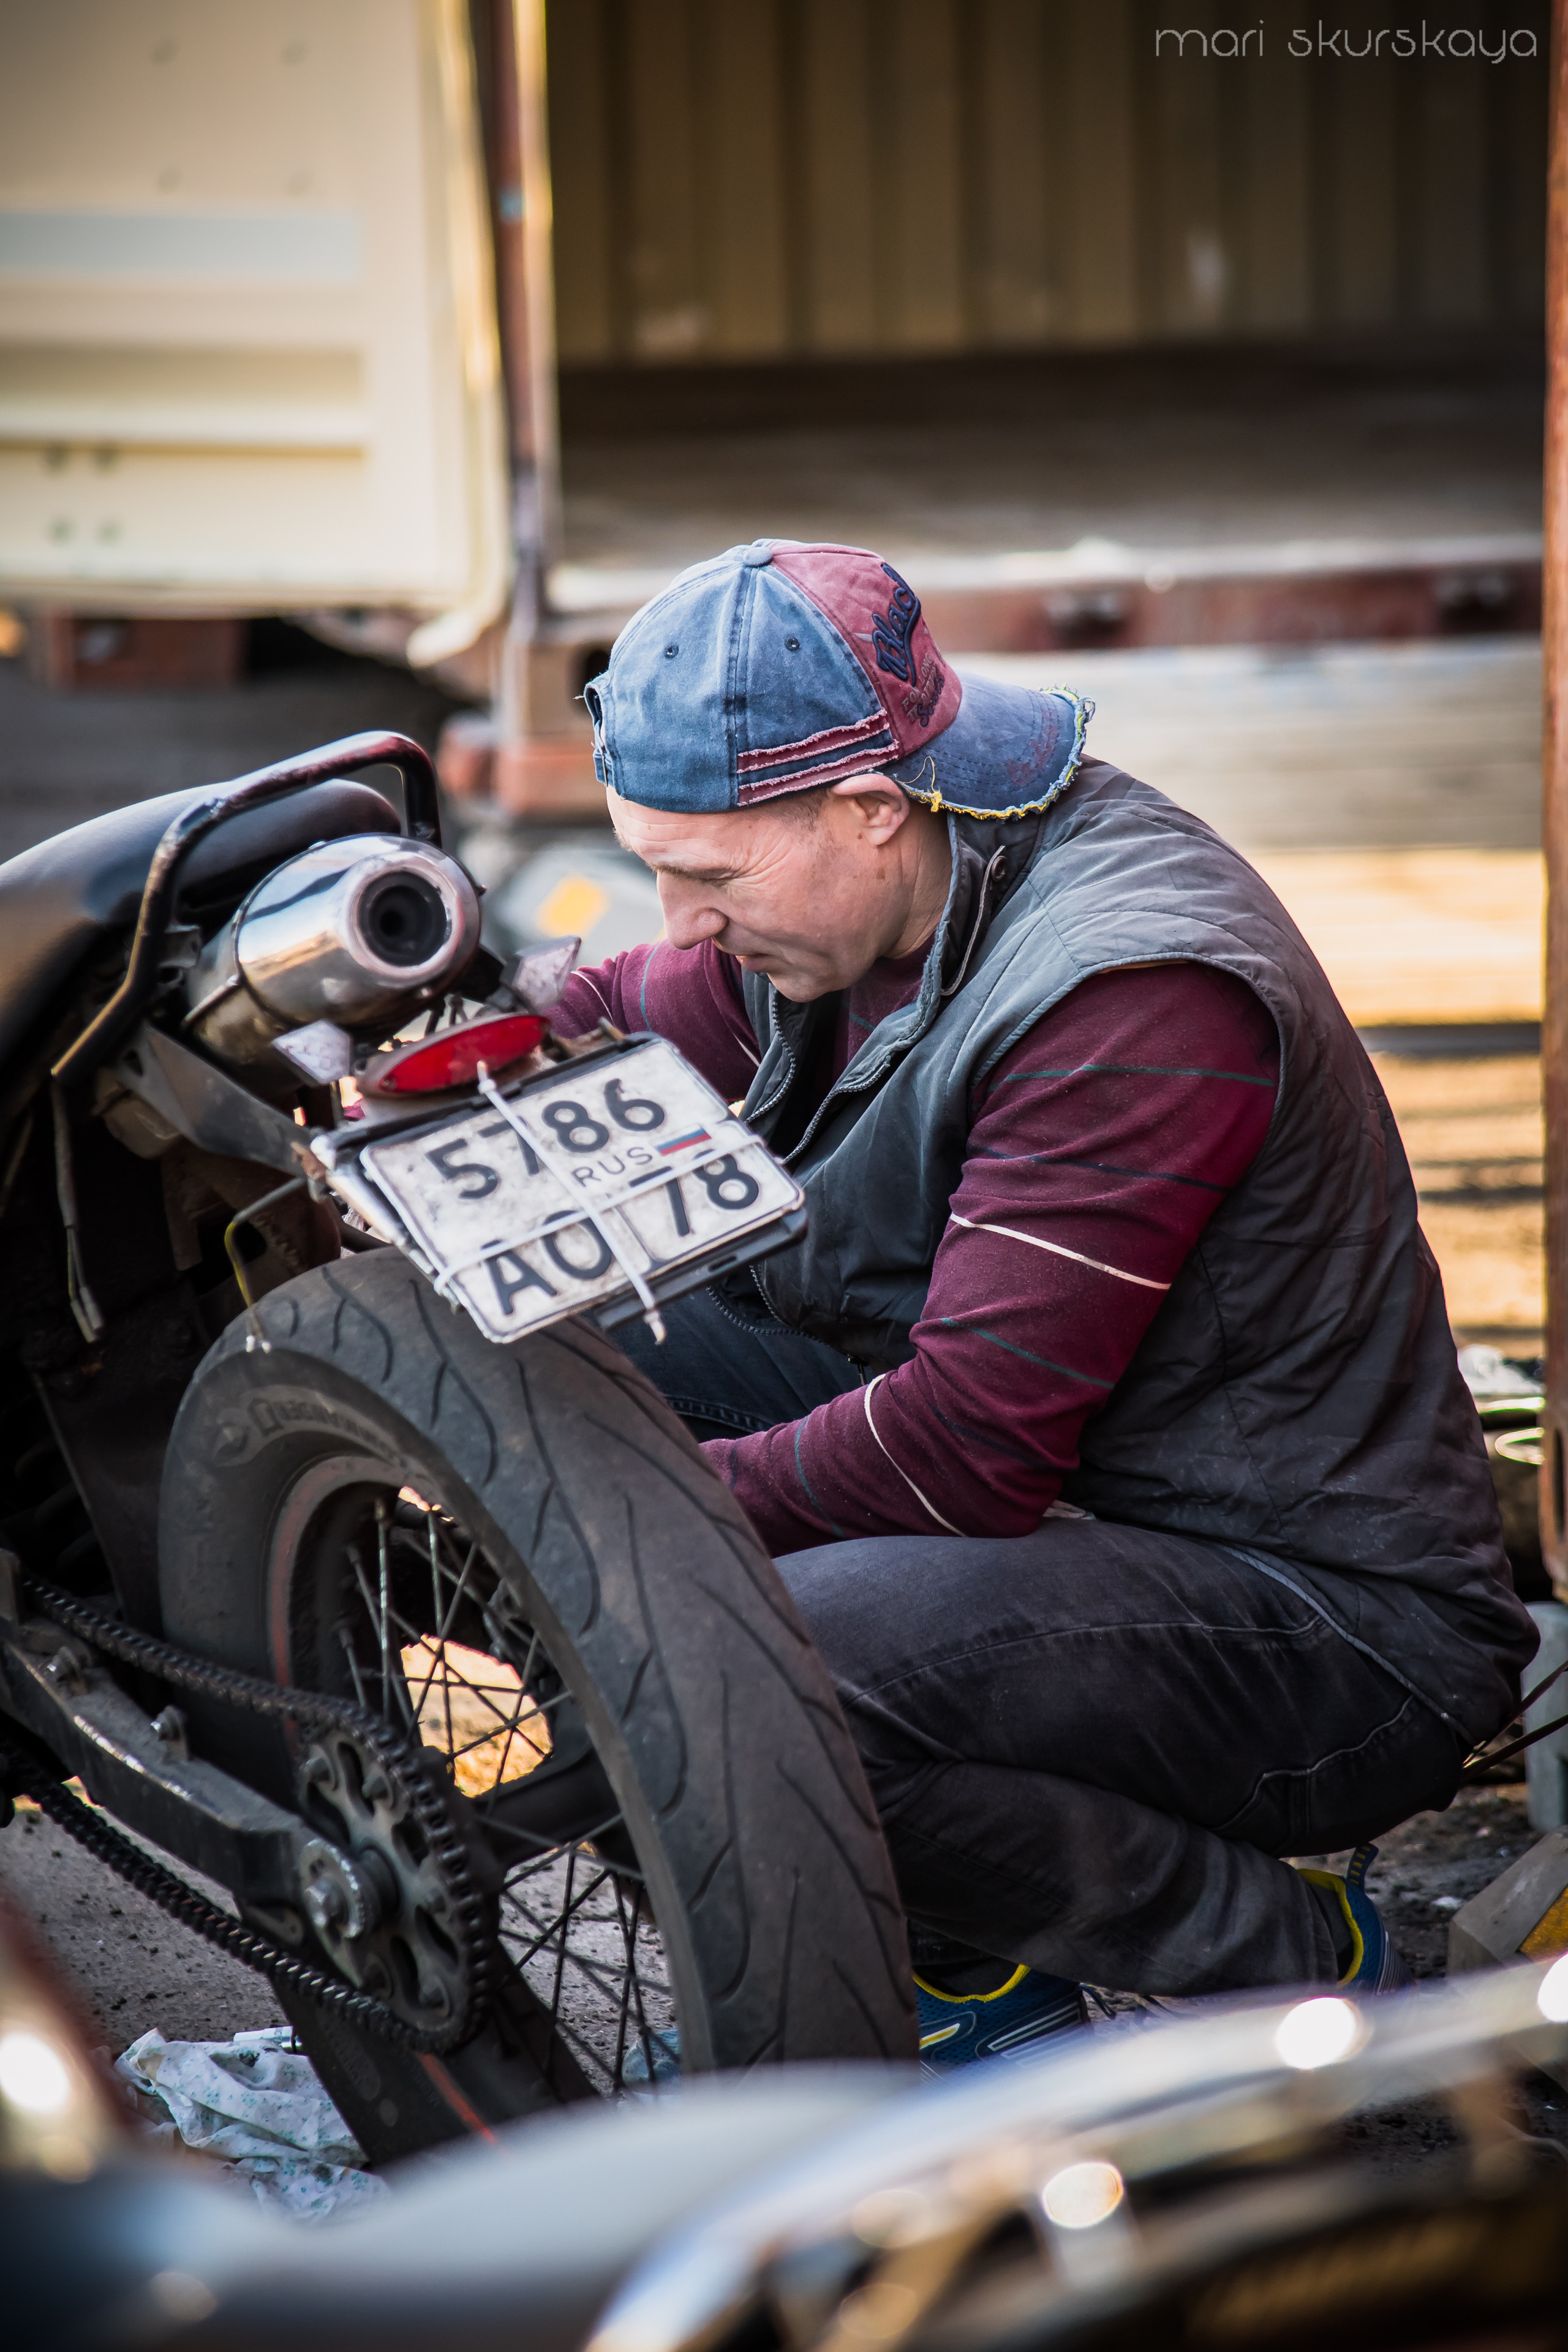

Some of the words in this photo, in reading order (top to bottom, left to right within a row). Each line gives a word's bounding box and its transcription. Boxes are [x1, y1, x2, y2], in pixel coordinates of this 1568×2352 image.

[424, 1078, 665, 1200] 5786
[571, 1146, 654, 1188] RUS
[630, 1149, 760, 1237] 78
